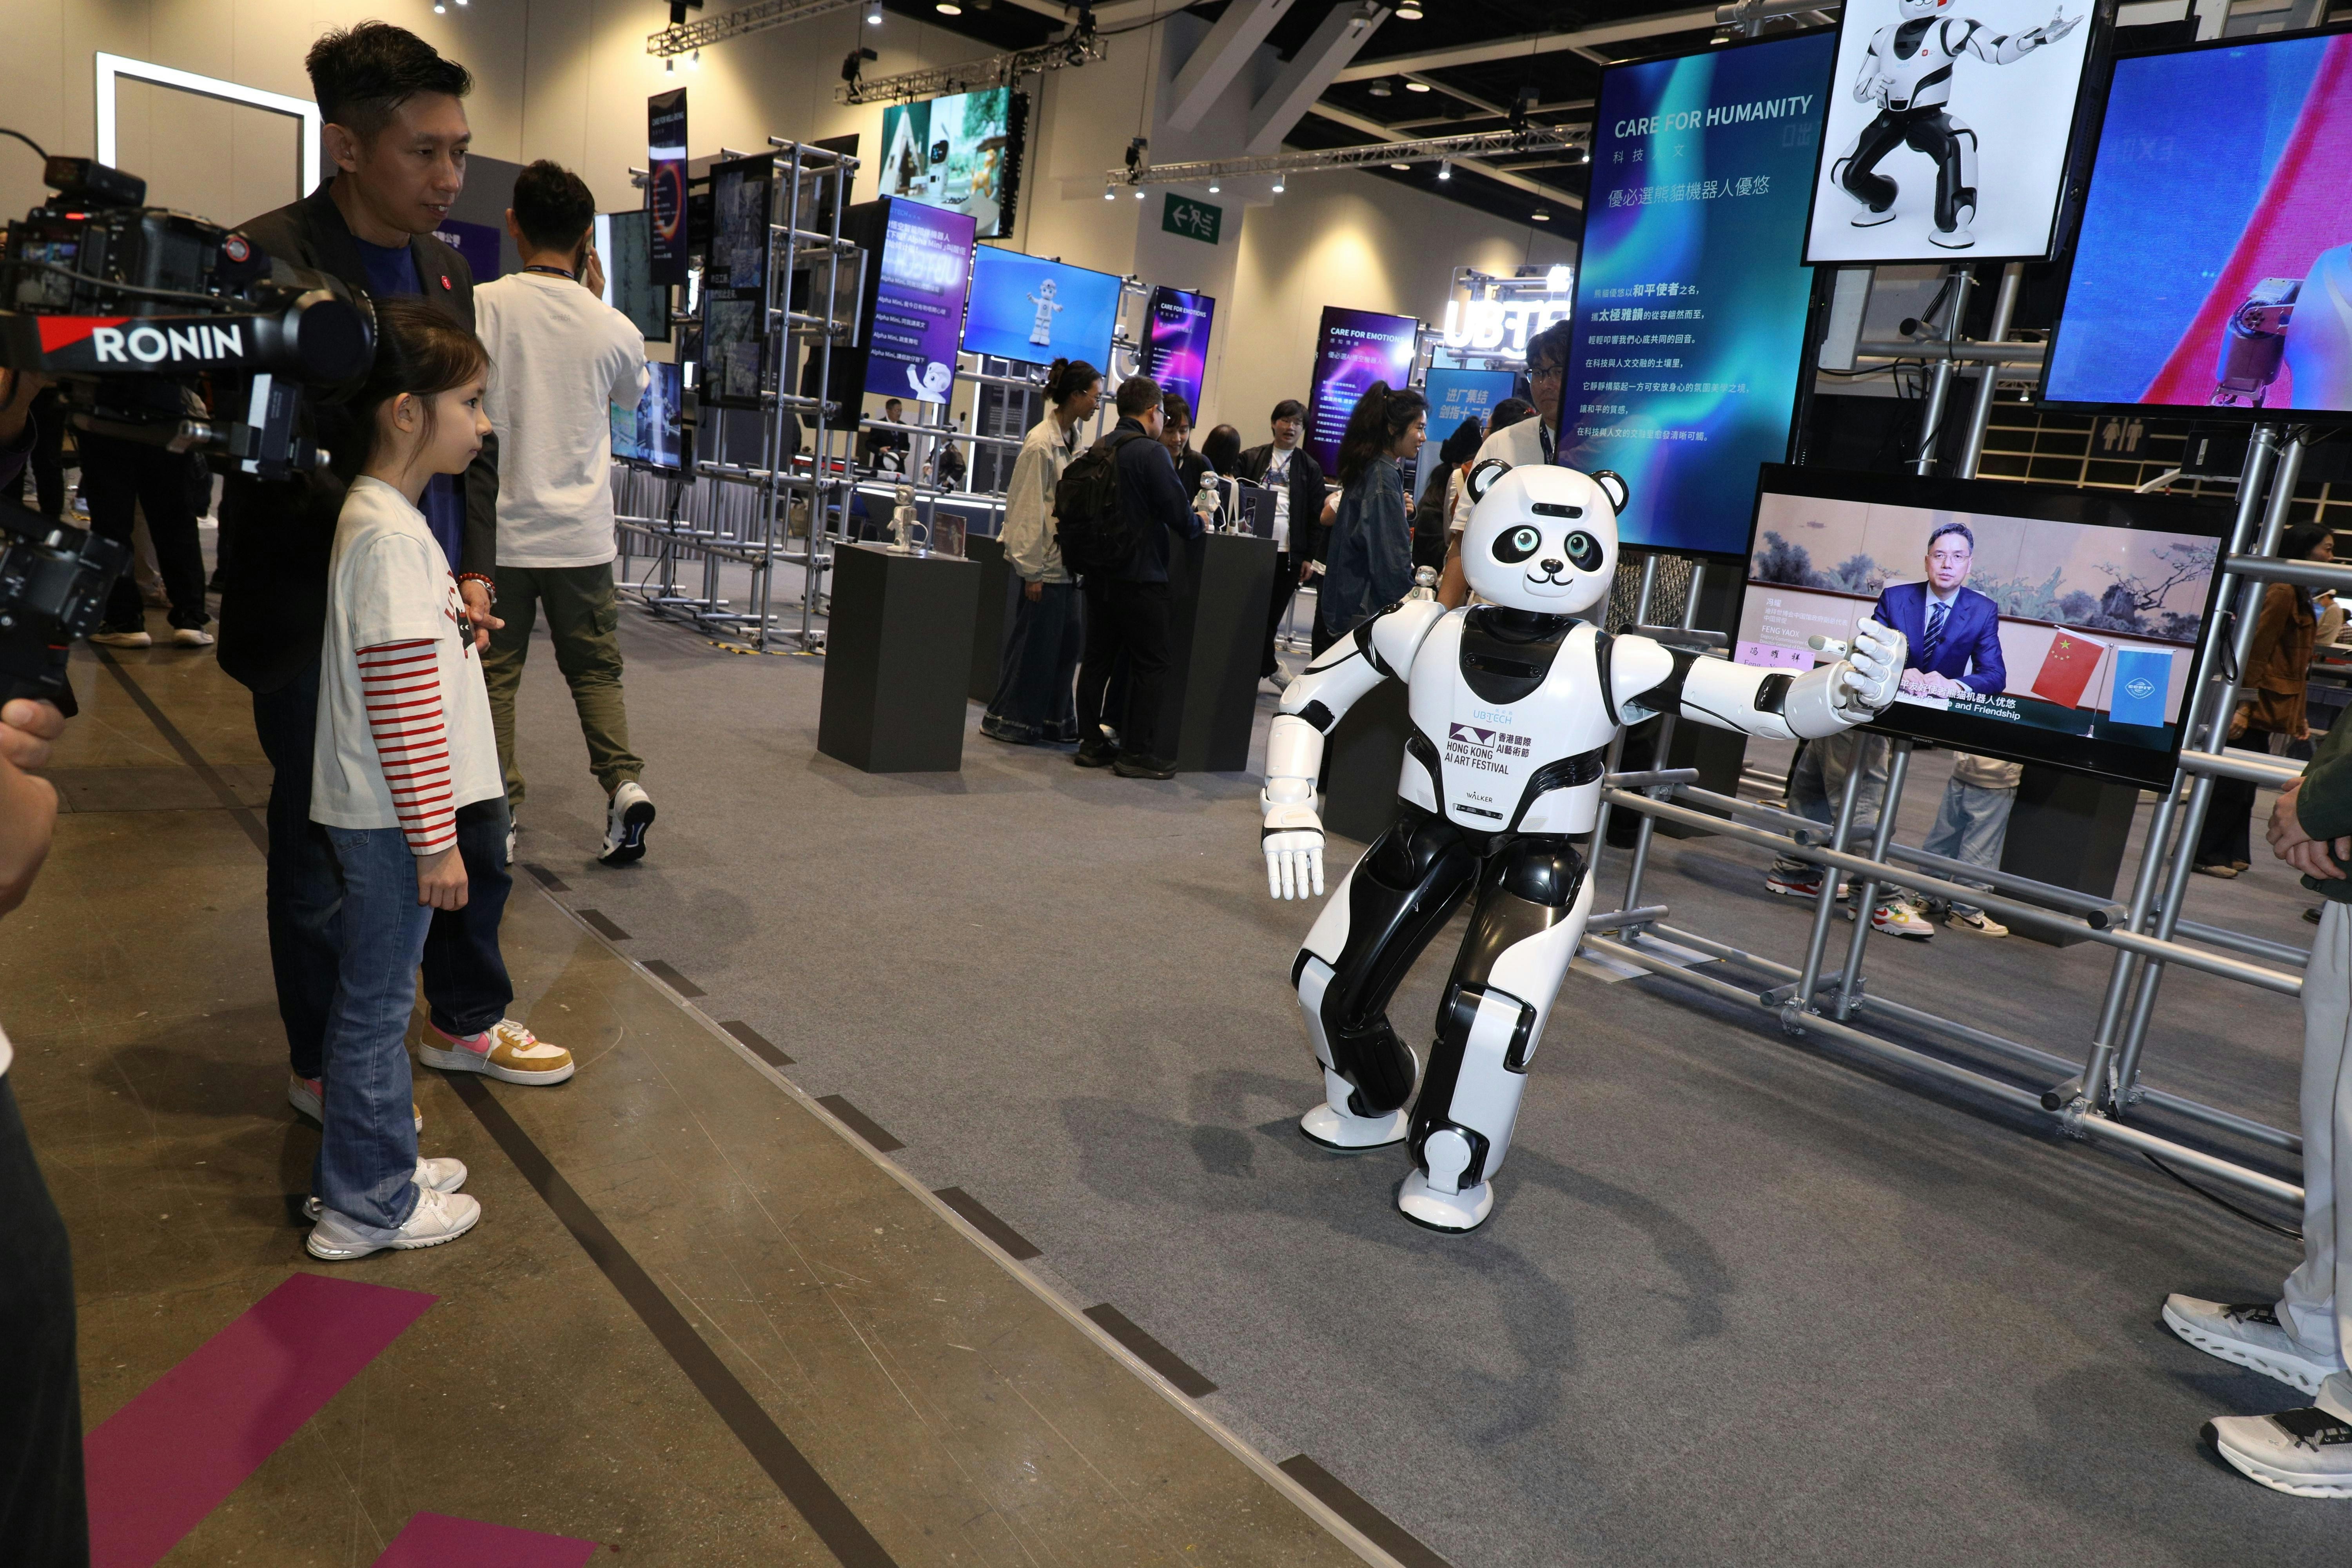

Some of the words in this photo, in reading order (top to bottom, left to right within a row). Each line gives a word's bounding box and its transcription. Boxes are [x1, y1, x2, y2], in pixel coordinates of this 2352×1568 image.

[1615, 116, 1660, 138] CARE
[1664, 111, 1702, 131] FOR
[1706, 94, 1813, 126] HUMANITY
[1608, 175, 1770, 208] 優必選熊貓機器人優悠
[908, 234, 927, 246] Alpha
[928, 240, 942, 250] Mini
[1183, 308, 1207, 318] EMOTIONS
[873, 332, 887, 340] Alpha
[1330, 327, 1350, 336] CARE
[1350, 330, 1365, 338] FOR
[1366, 332, 1405, 343] EMOTIONS
[93, 325, 244, 363] RONIN
[1446, 388, 1489, 404] 进厂集结
[1766, 598, 1782, 608] 冯耀
[1760, 633, 1775, 642] Deputy
[1775, 636, 1804, 645] Commissioner
[1762, 625, 1780, 635] FENG
[1782, 628, 1800, 638] YAOX
[1926, 696, 1953, 707] Peace
[1955, 702, 1972, 711] and
[1974, 704, 2021, 721] Friendship
[1474, 710, 1512, 725] UBTECH
[1499, 732, 1532, 747] 香港國際
[1446, 740, 1469, 754] HONG
[1470, 746, 1493, 760] KONG
[1445, 752, 1453, 762] AI
[1454, 755, 1470, 766] ART
[1472, 758, 1509, 775] FESTIVAL
